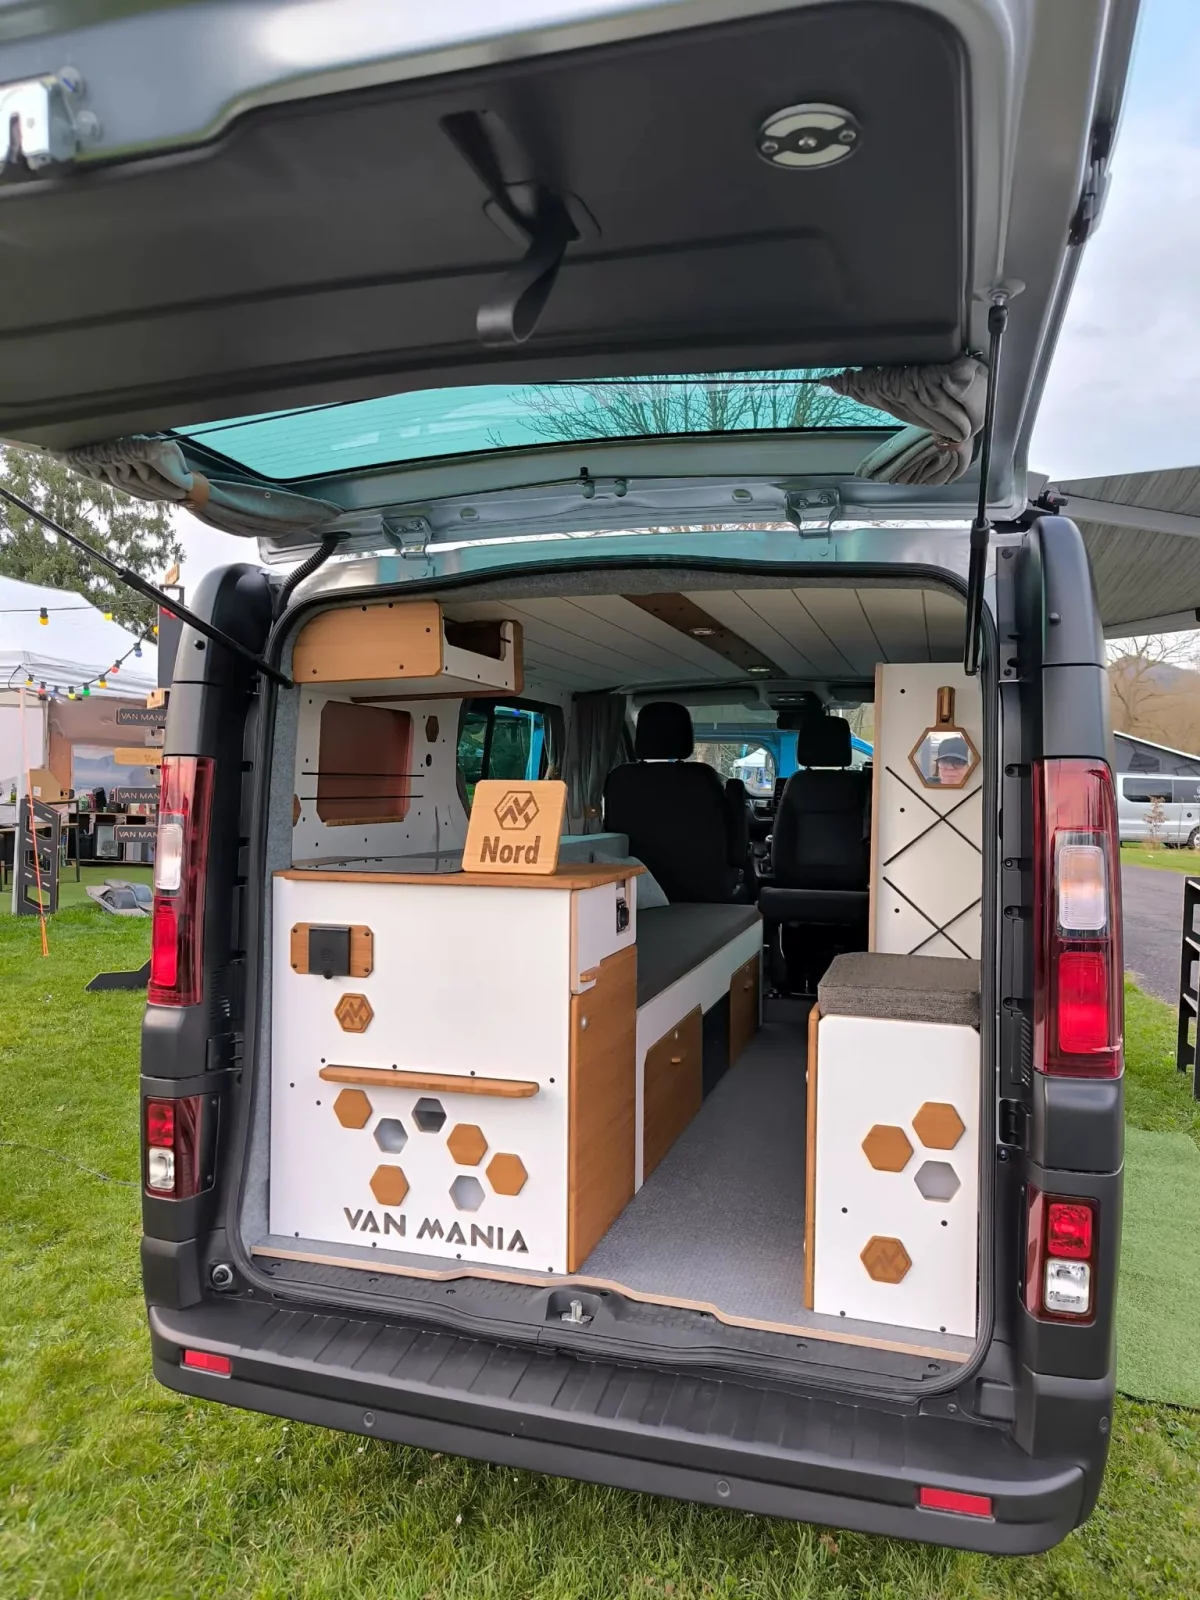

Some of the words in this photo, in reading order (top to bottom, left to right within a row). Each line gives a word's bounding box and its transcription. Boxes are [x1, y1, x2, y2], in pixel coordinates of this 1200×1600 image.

[121, 712, 138, 720] VAN
[479, 835, 541, 865] Nord
[343, 1207, 406, 1237] VAN
[416, 1217, 529, 1253] MANIA
